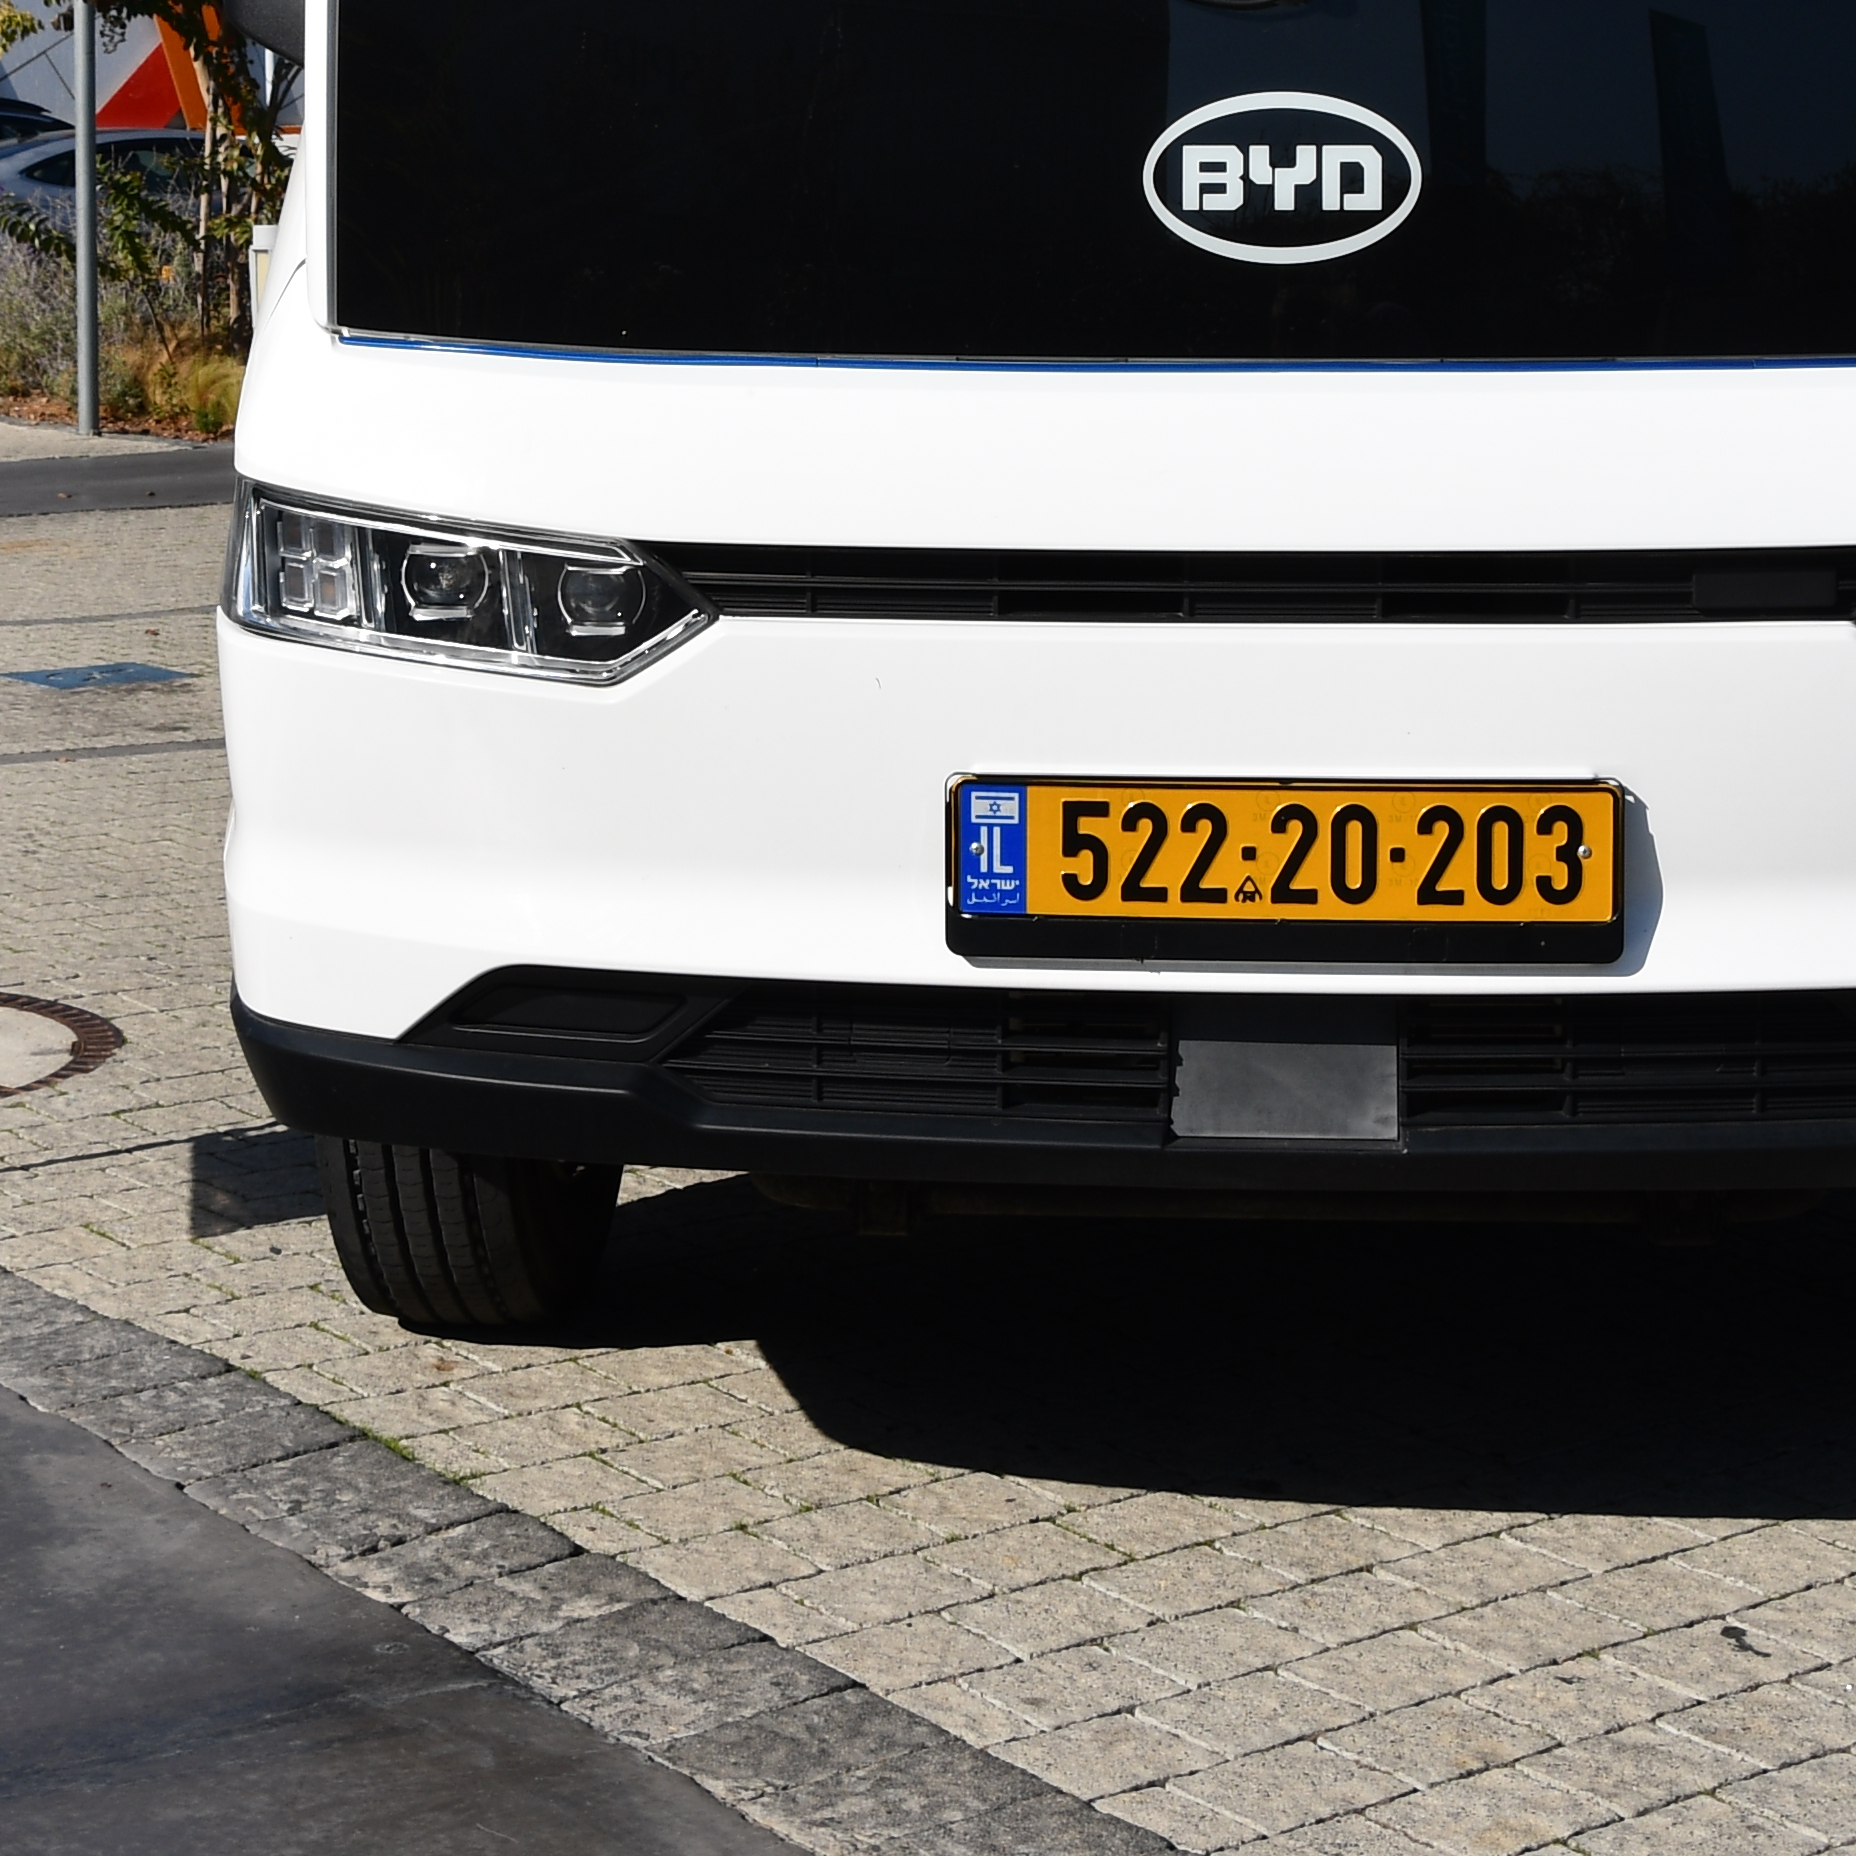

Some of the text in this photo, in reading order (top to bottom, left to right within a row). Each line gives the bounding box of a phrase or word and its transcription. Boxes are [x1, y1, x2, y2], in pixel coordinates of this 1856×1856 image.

[1182, 145, 1383, 211] BYD
[980, 826, 1014, 874] IL
[967, 875, 1020, 890] ישראל
